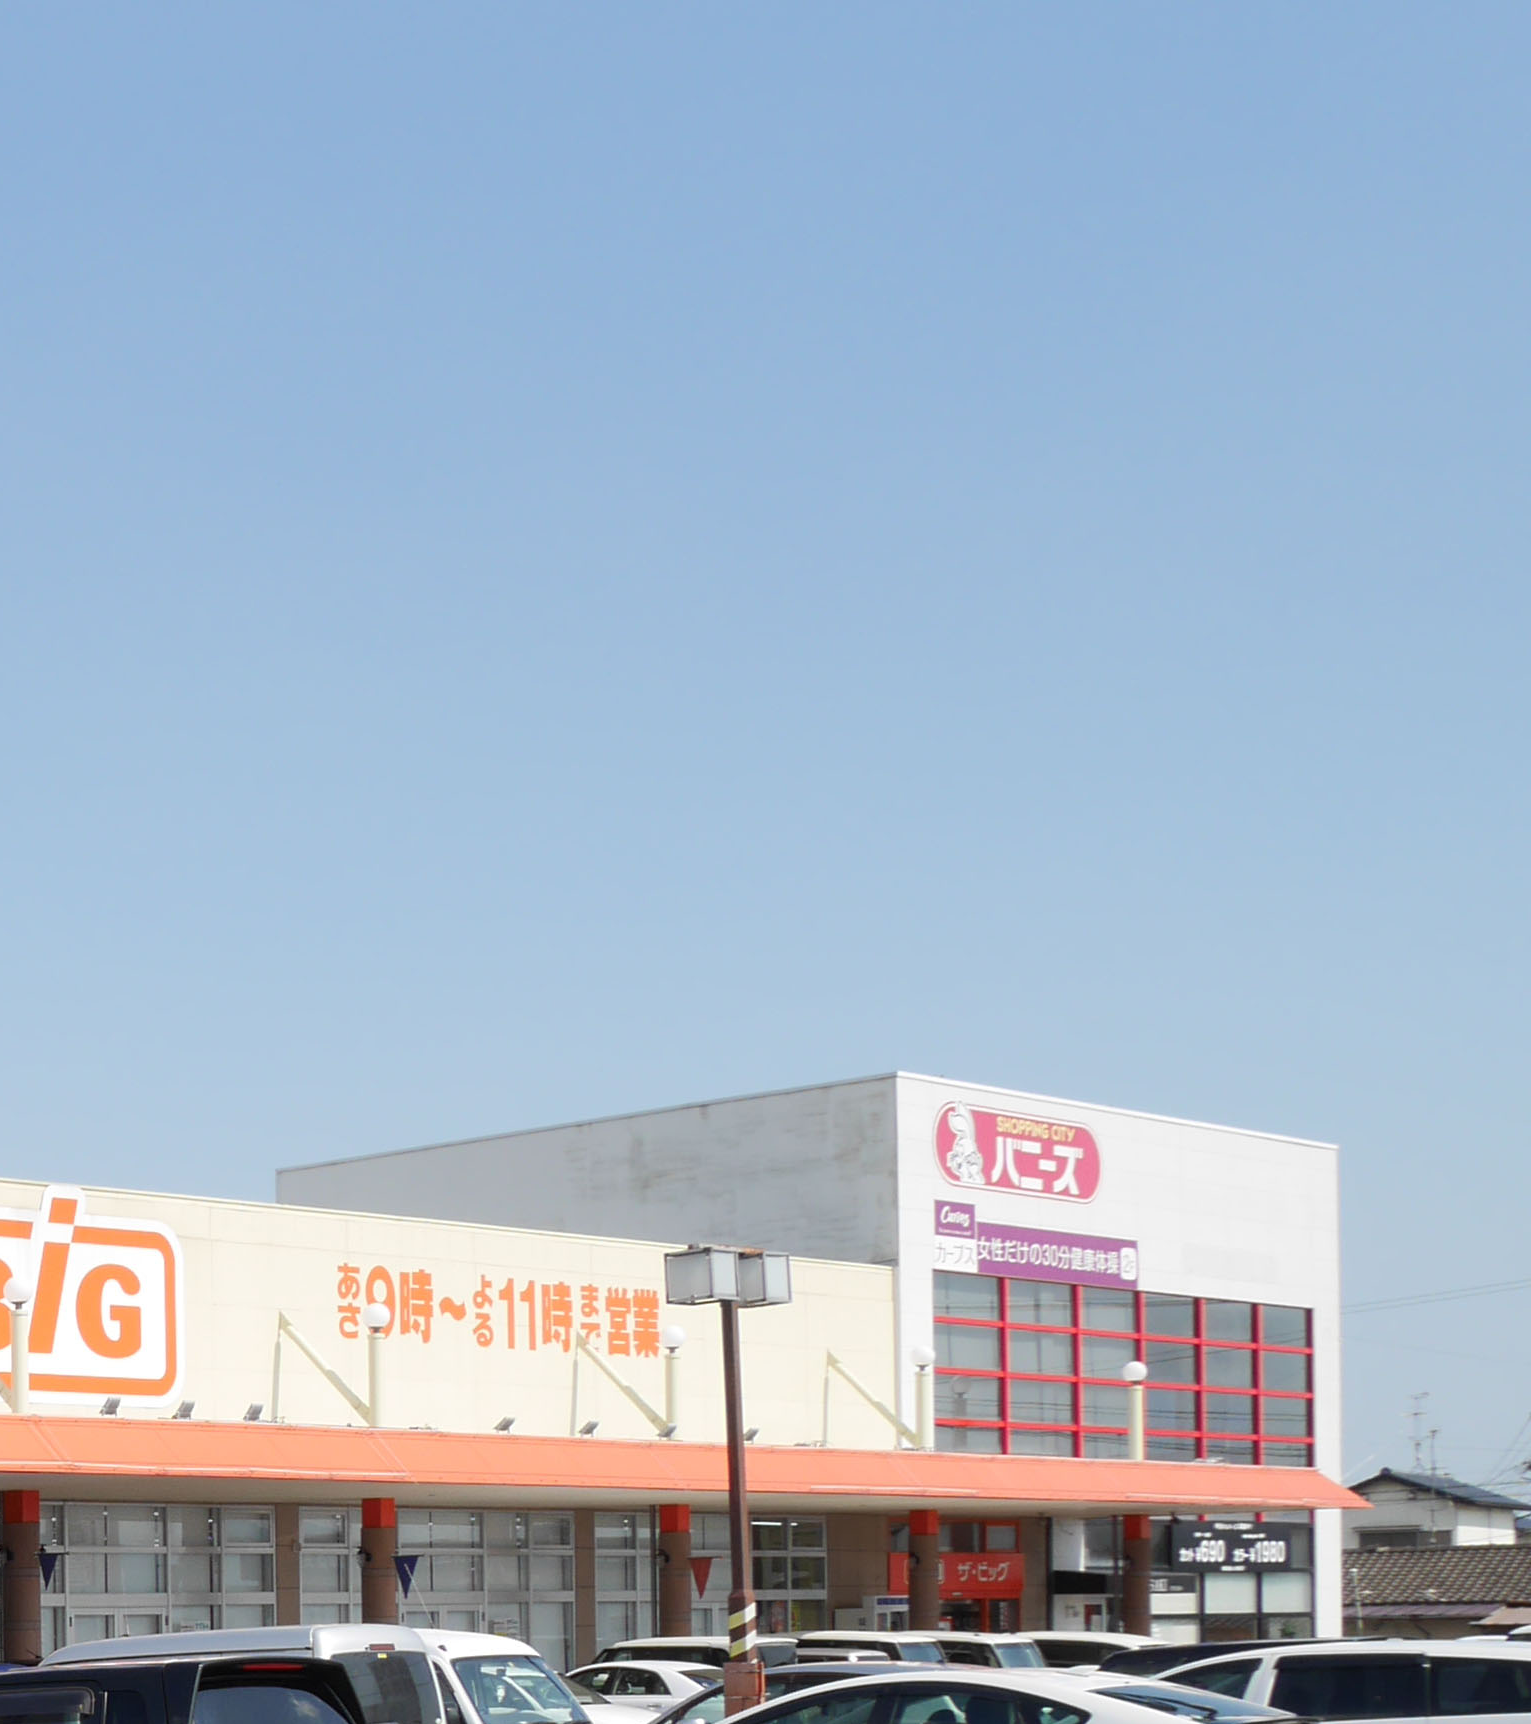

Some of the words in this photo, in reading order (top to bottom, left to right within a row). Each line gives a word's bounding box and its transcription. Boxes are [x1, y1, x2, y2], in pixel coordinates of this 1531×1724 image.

[996, 1115, 1050, 1140] SHOPPING
[1051, 1125, 1076, 1143] CITY
[991, 1136, 1084, 1195] バニーズ
